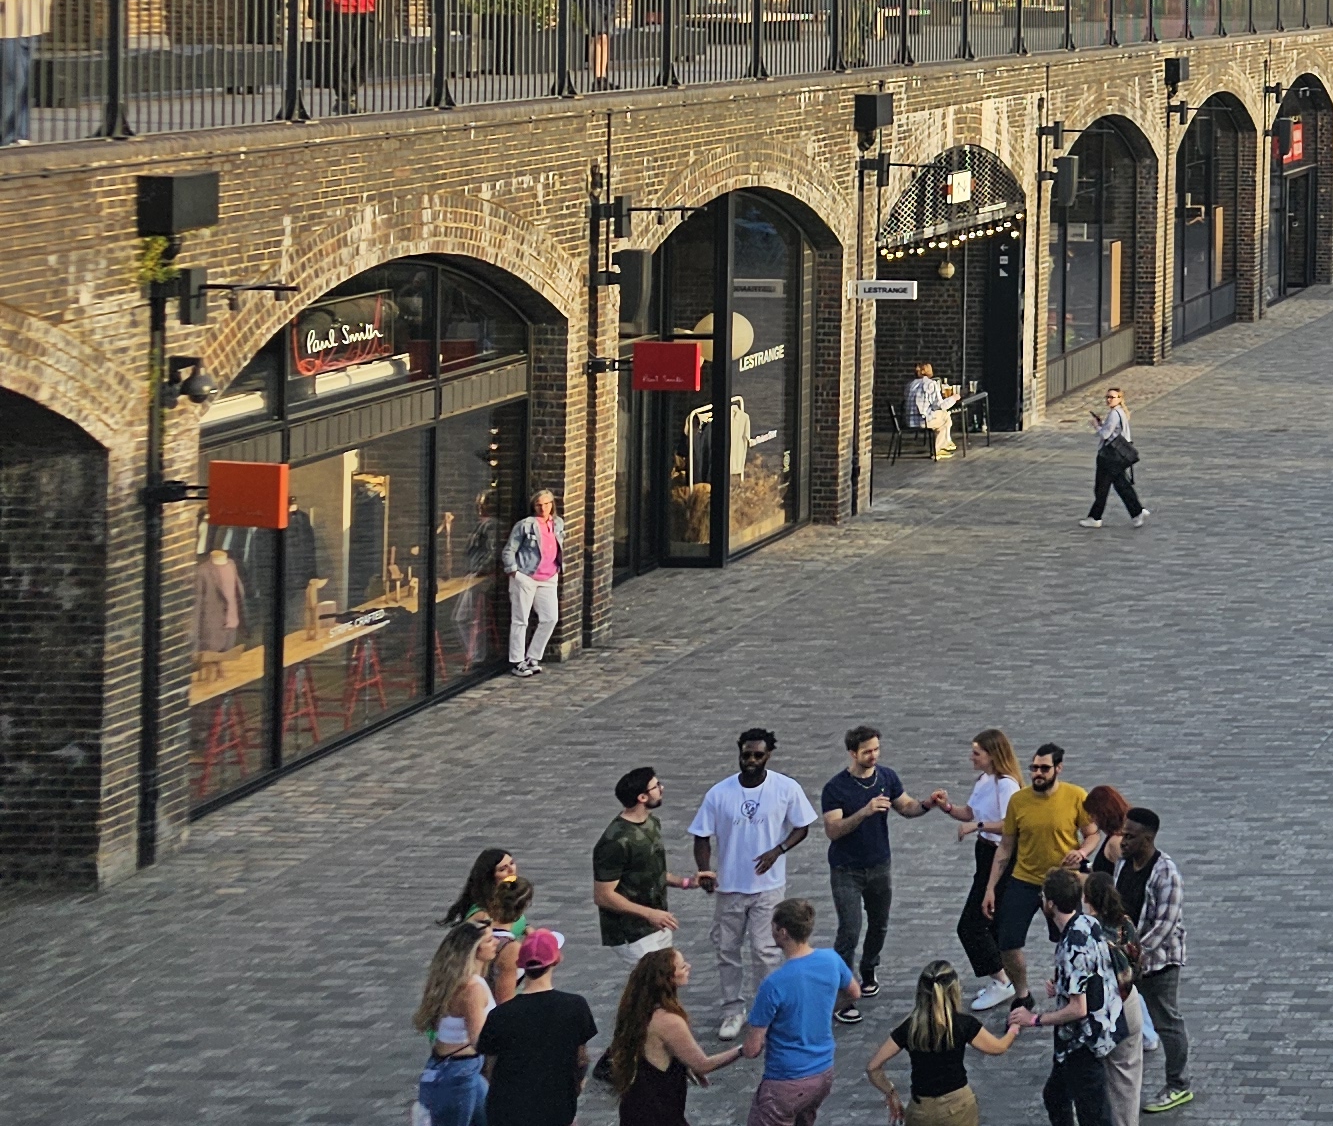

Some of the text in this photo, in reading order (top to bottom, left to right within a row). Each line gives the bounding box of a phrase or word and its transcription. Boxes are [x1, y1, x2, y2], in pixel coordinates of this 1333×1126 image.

[863, 286, 908, 294] LESTRANGE
[306, 323, 384, 354] Paul Smith
[739, 344, 785, 373] LESTRANGE
